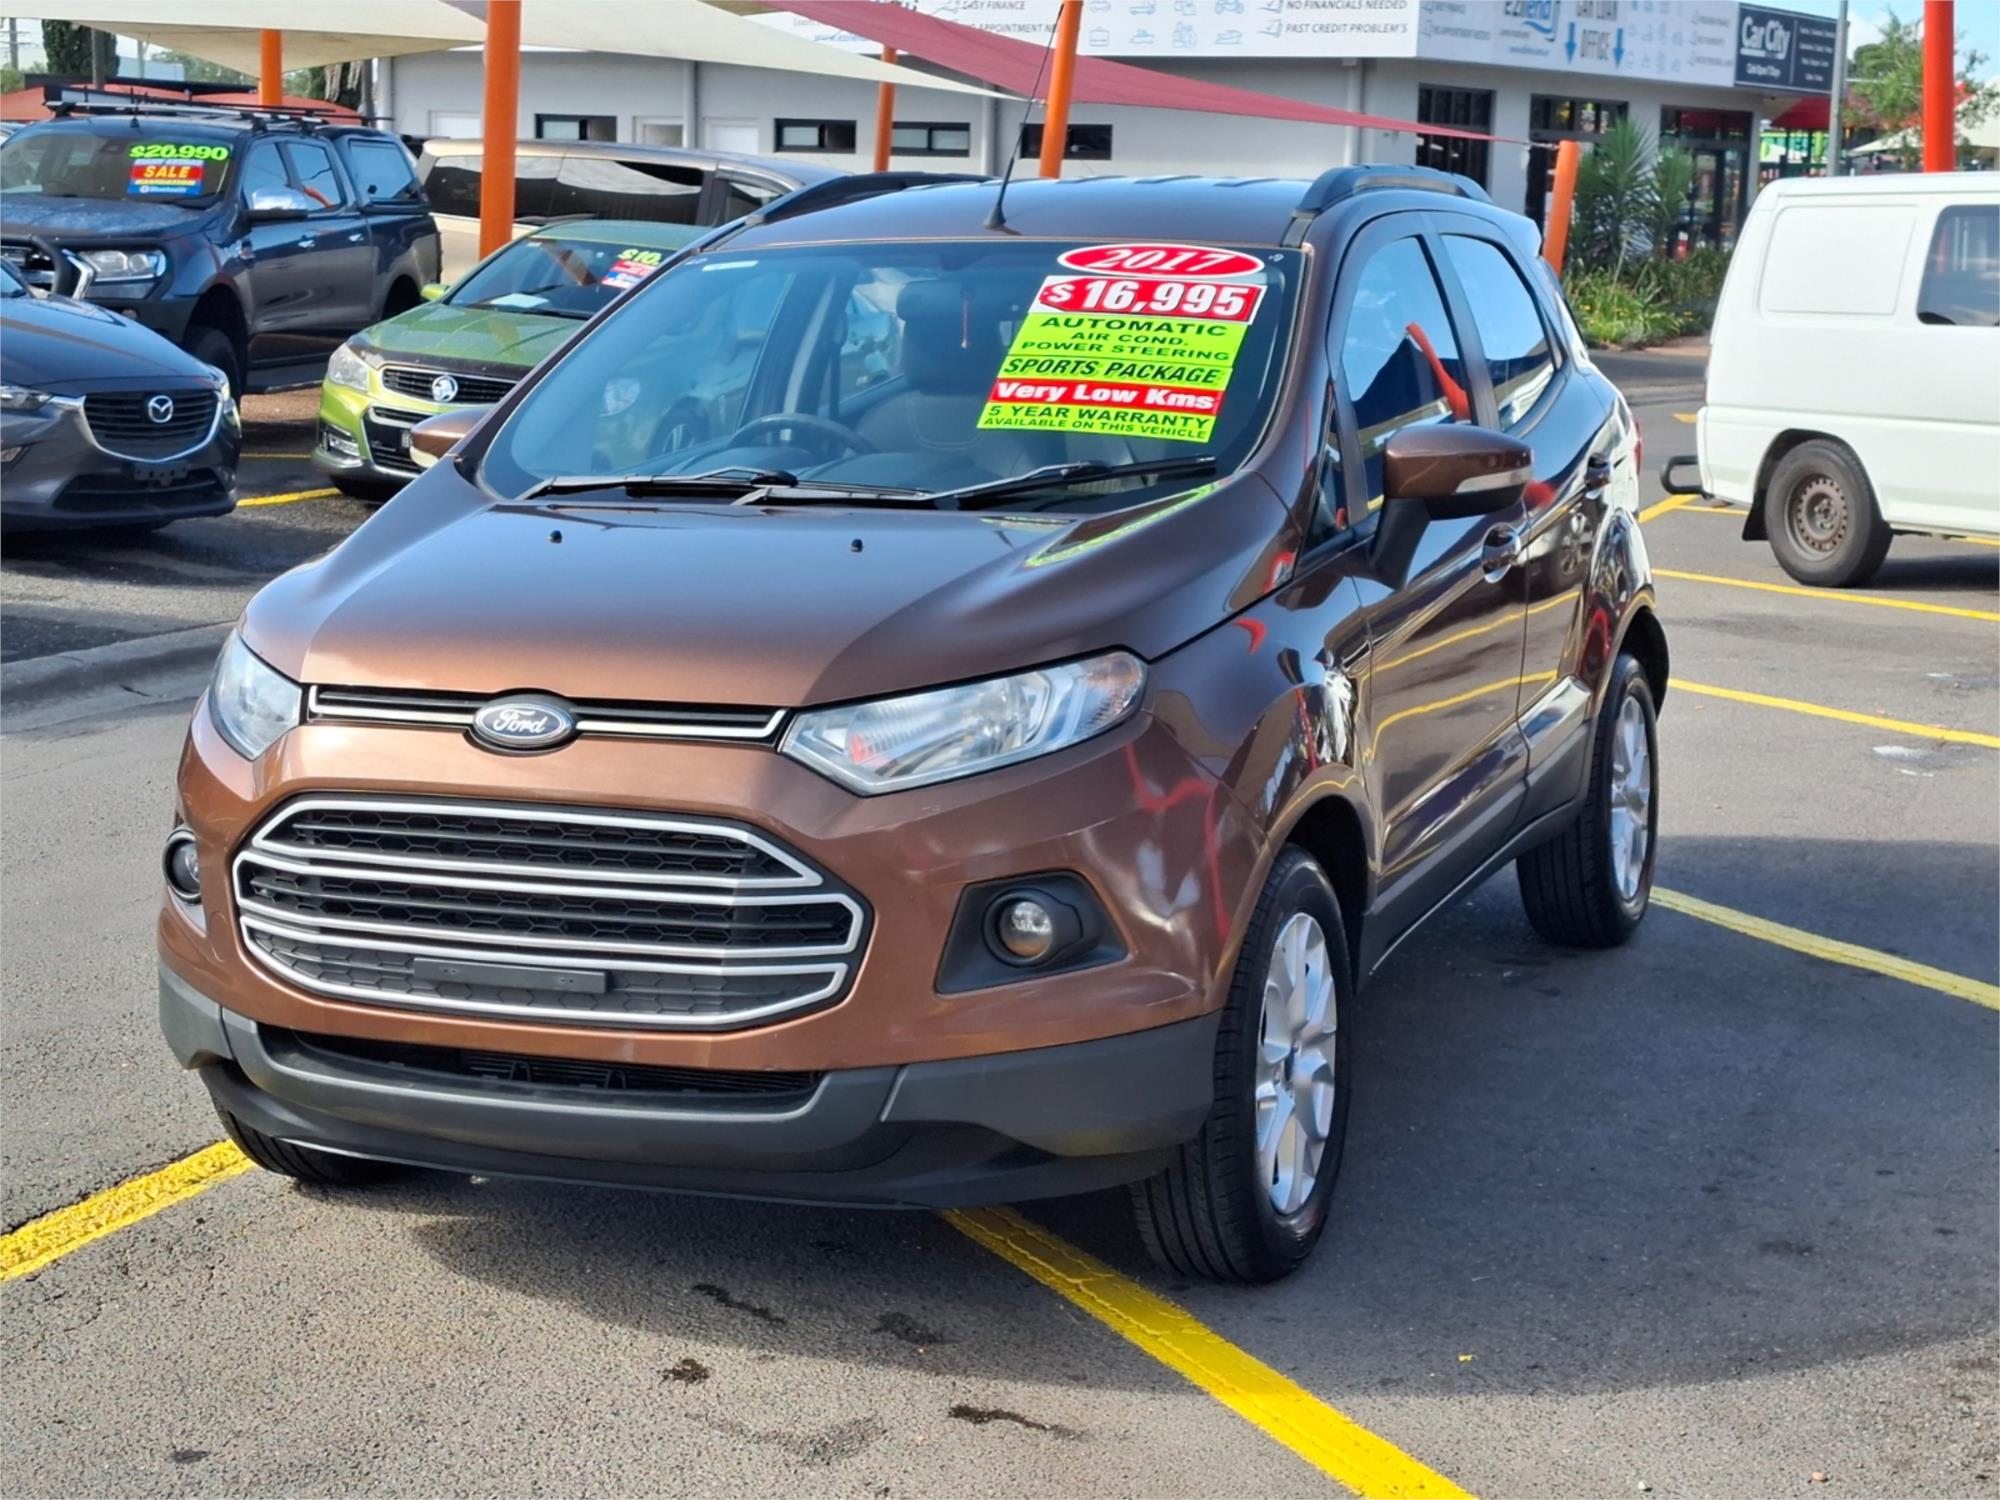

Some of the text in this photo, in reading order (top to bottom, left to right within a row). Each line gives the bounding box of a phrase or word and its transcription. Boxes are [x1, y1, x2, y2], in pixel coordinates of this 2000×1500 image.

[986, 1, 1025, 10] FINANCE
[1285, 0, 1408, 10] NO FINANCIALS NEEDED
[1285, 24, 1309, 33] PAST
[1312, 24, 1348, 33] CREDIT
[144, 166, 191, 178] SALE
[1085, 249, 1237, 272] 2017
[1040, 316, 1228, 337] AUTOMATIC
[1070, 331, 1190, 347] AIR COND.
[1020, 341, 1231, 362] POWER STEERING
[1003, 358, 1221, 385] SPORTS PACKAGE
[996, 381, 1216, 410] Very Low Kms
[988, 405, 1210, 430] 5 YEAR WARRANTY
[983, 417, 1208, 440] AVAILABLE ON THIS VEHICLE
[492, 708, 548, 734] Ford
